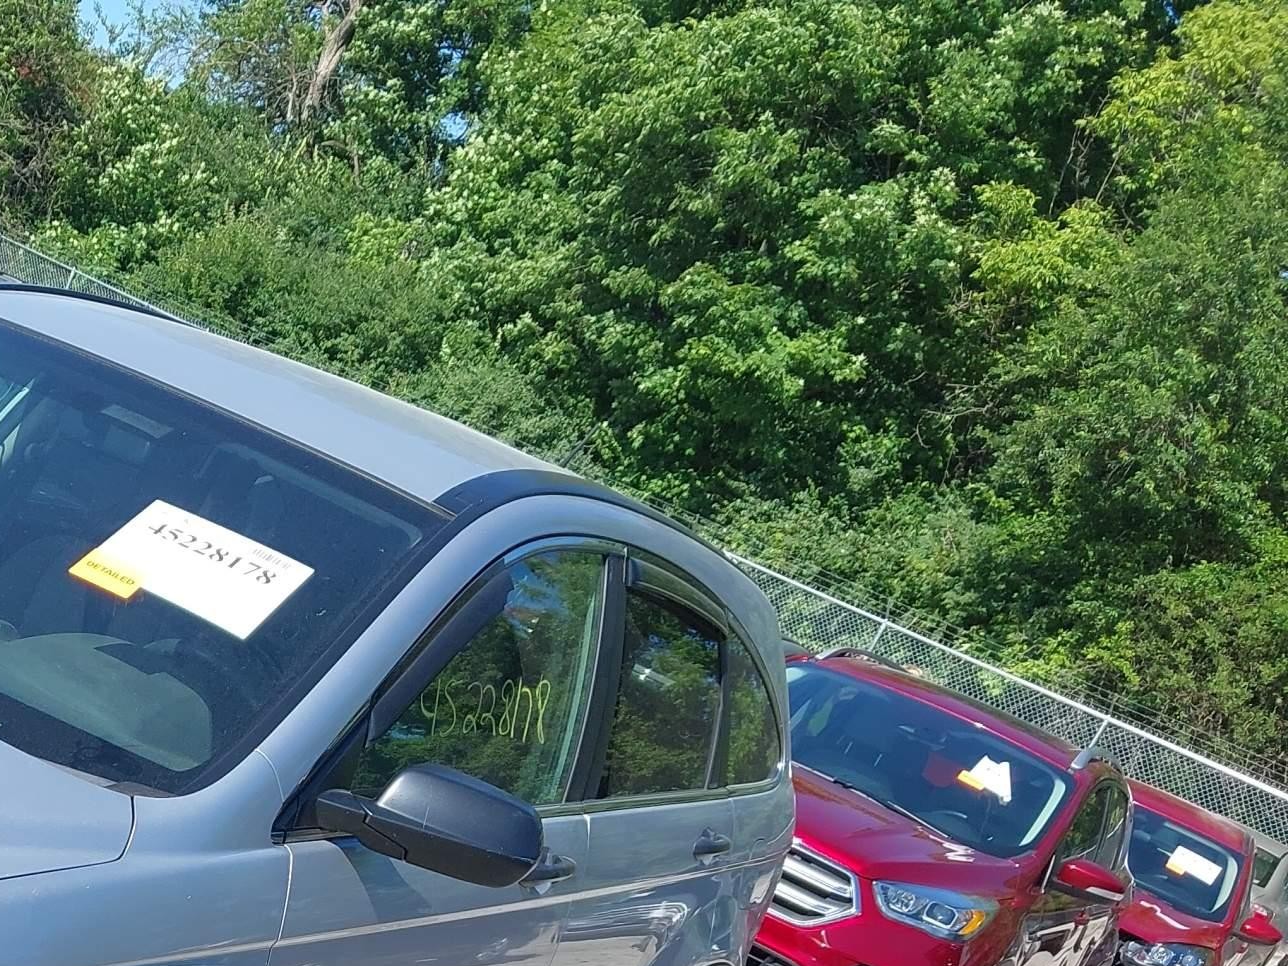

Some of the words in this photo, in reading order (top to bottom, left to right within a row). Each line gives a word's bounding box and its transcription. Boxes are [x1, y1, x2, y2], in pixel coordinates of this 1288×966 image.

[86, 560, 135, 587] DETAILED
[148, 523, 277, 585] 45228178
[420, 674, 551, 744] 45228178
